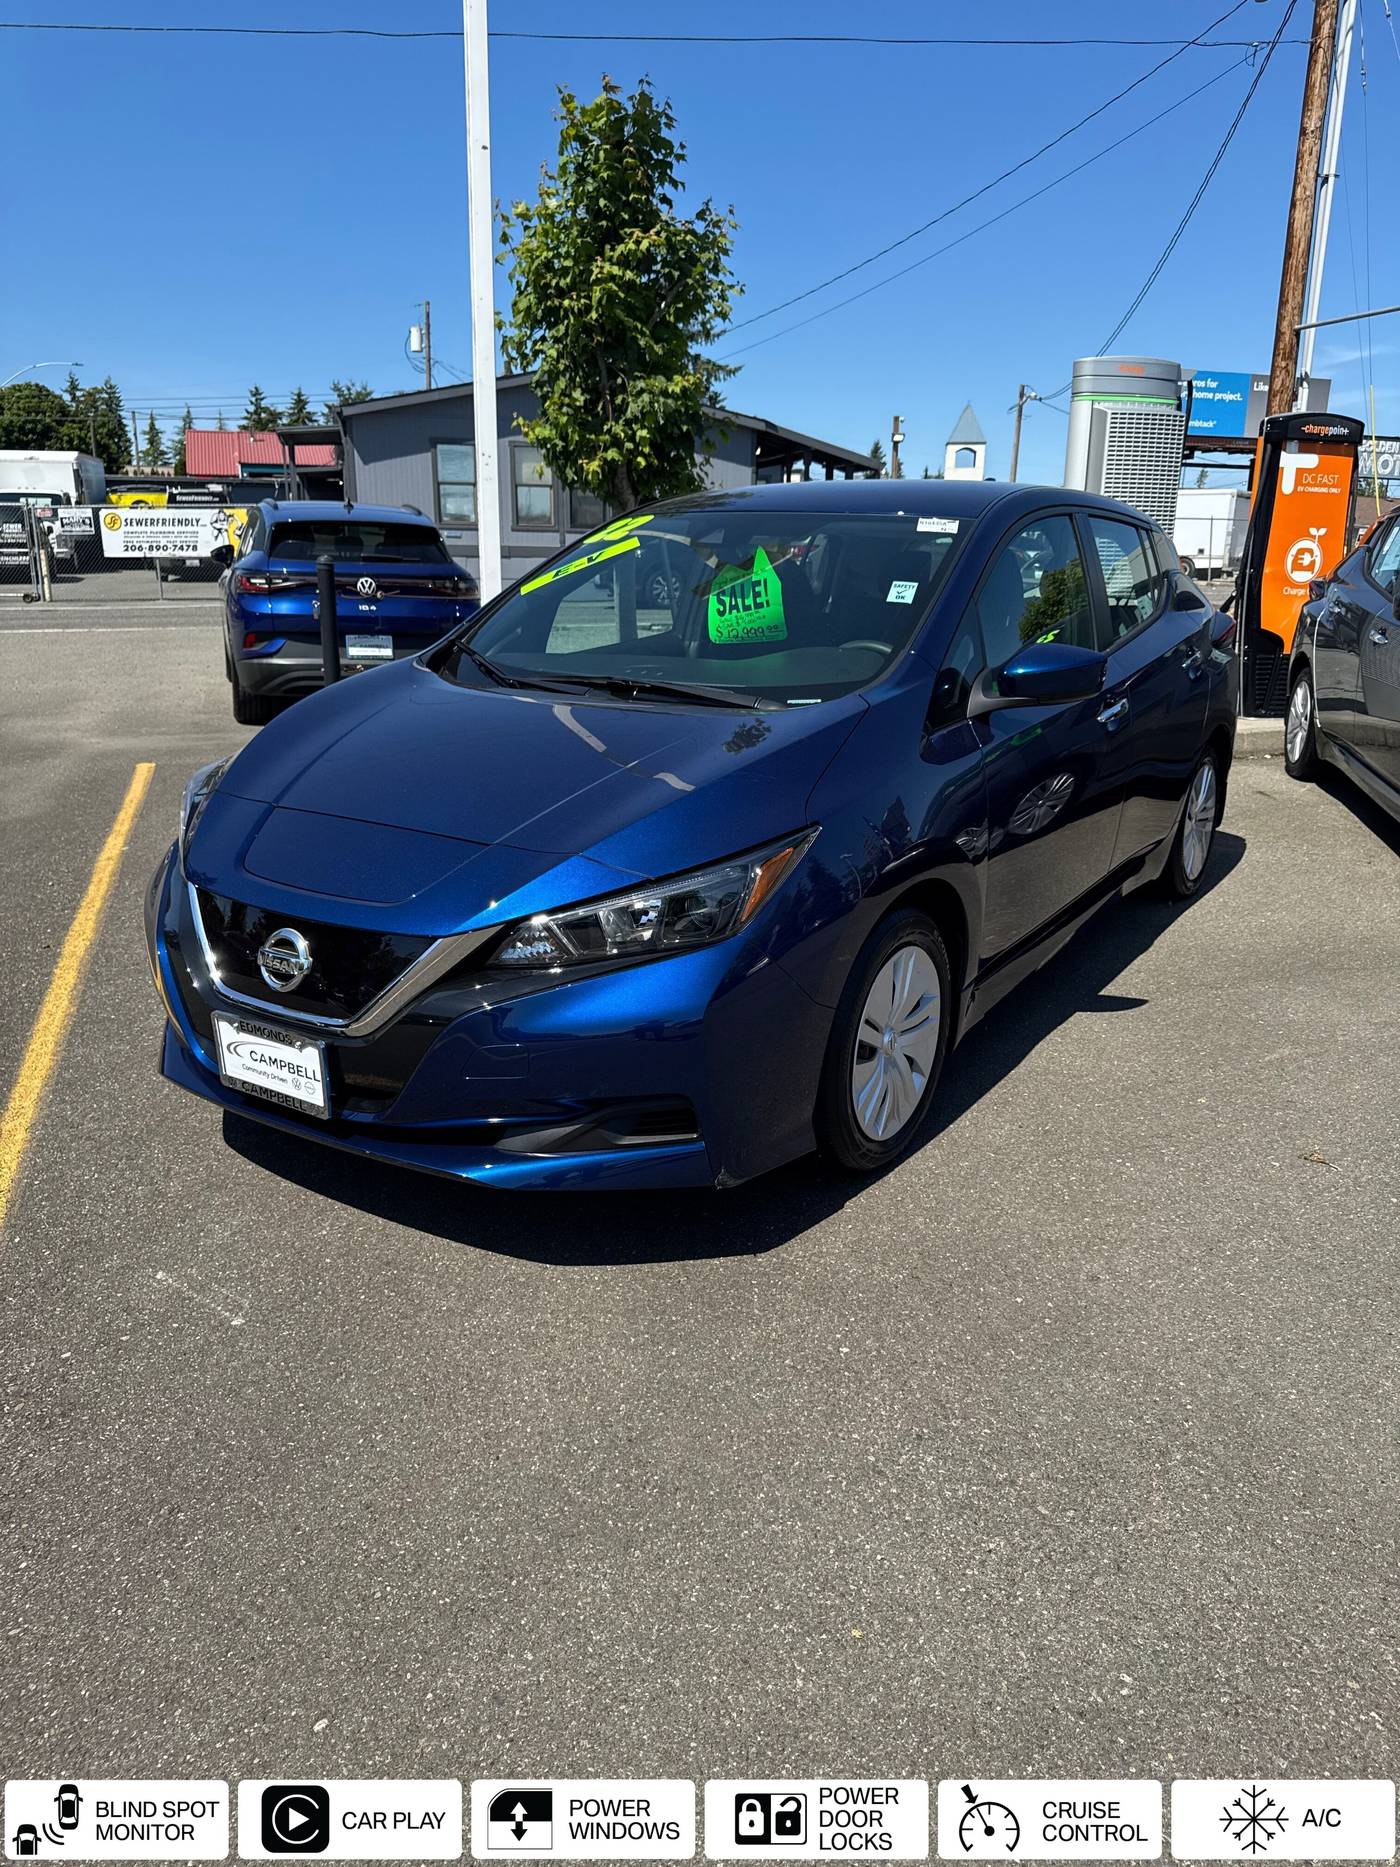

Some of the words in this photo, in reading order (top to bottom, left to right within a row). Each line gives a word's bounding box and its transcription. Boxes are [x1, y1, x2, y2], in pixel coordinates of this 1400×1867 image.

[1206, 378, 1219, 388] for
[1302, 473, 1316, 484] DC
[1316, 474, 1340, 485] FAST
[716, 577, 771, 618] SALE!
[1283, 587, 1306, 596] Charge
[259, 951, 300, 975] NISSAN
[239, 1020, 293, 1045] EDMONDS
[241, 1063, 270, 1080] Community
[249, 1050, 321, 1083] CAMPBELL
[241, 1081, 307, 1112] CAMPBELL
